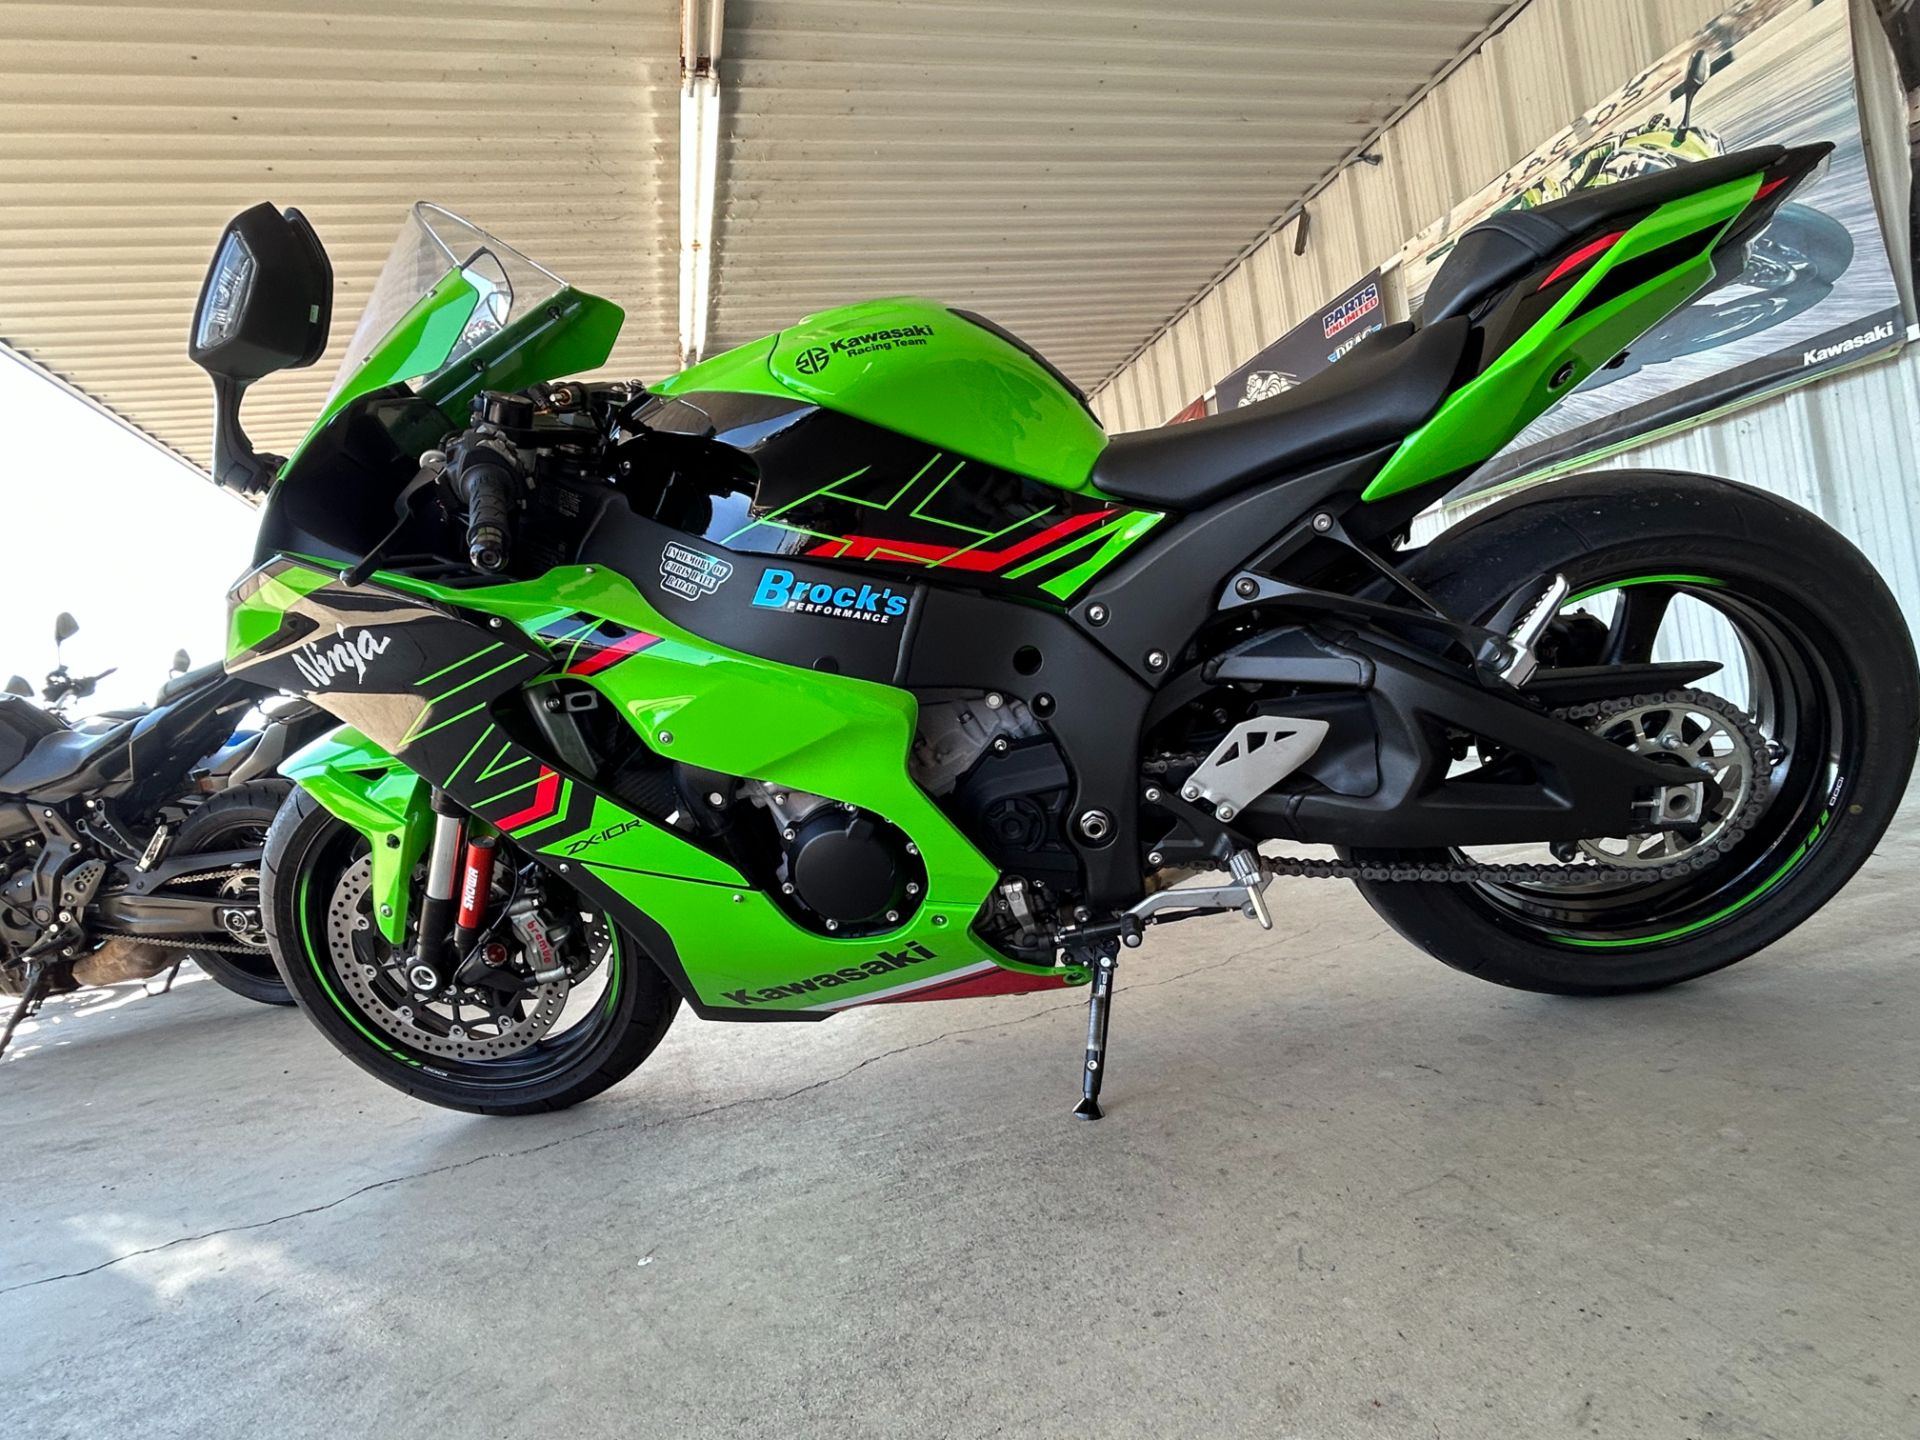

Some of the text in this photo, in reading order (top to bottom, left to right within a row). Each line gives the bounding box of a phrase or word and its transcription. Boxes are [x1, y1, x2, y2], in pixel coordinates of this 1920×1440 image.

[1324, 284, 1376, 329] PARTS
[1326, 298, 1378, 337] UNLIMITED
[830, 325, 934, 353] Kawasaki
[847, 338, 927, 358] Racing Team
[1803, 321, 1894, 366] Kawasaki
[664, 561, 692, 577] CHRIS
[676, 550, 712, 571] MEMORY
[666, 575, 698, 596] RADAR
[752, 568, 907, 616] Brock's
[787, 600, 890, 624] PERFORMANCE
[292, 623, 391, 688] Ninja
[564, 819, 643, 856] ZX-10R
[463, 866, 479, 911] SHOWA
[527, 920, 552, 964] brembo
[721, 940, 938, 1006] Kawasaki
